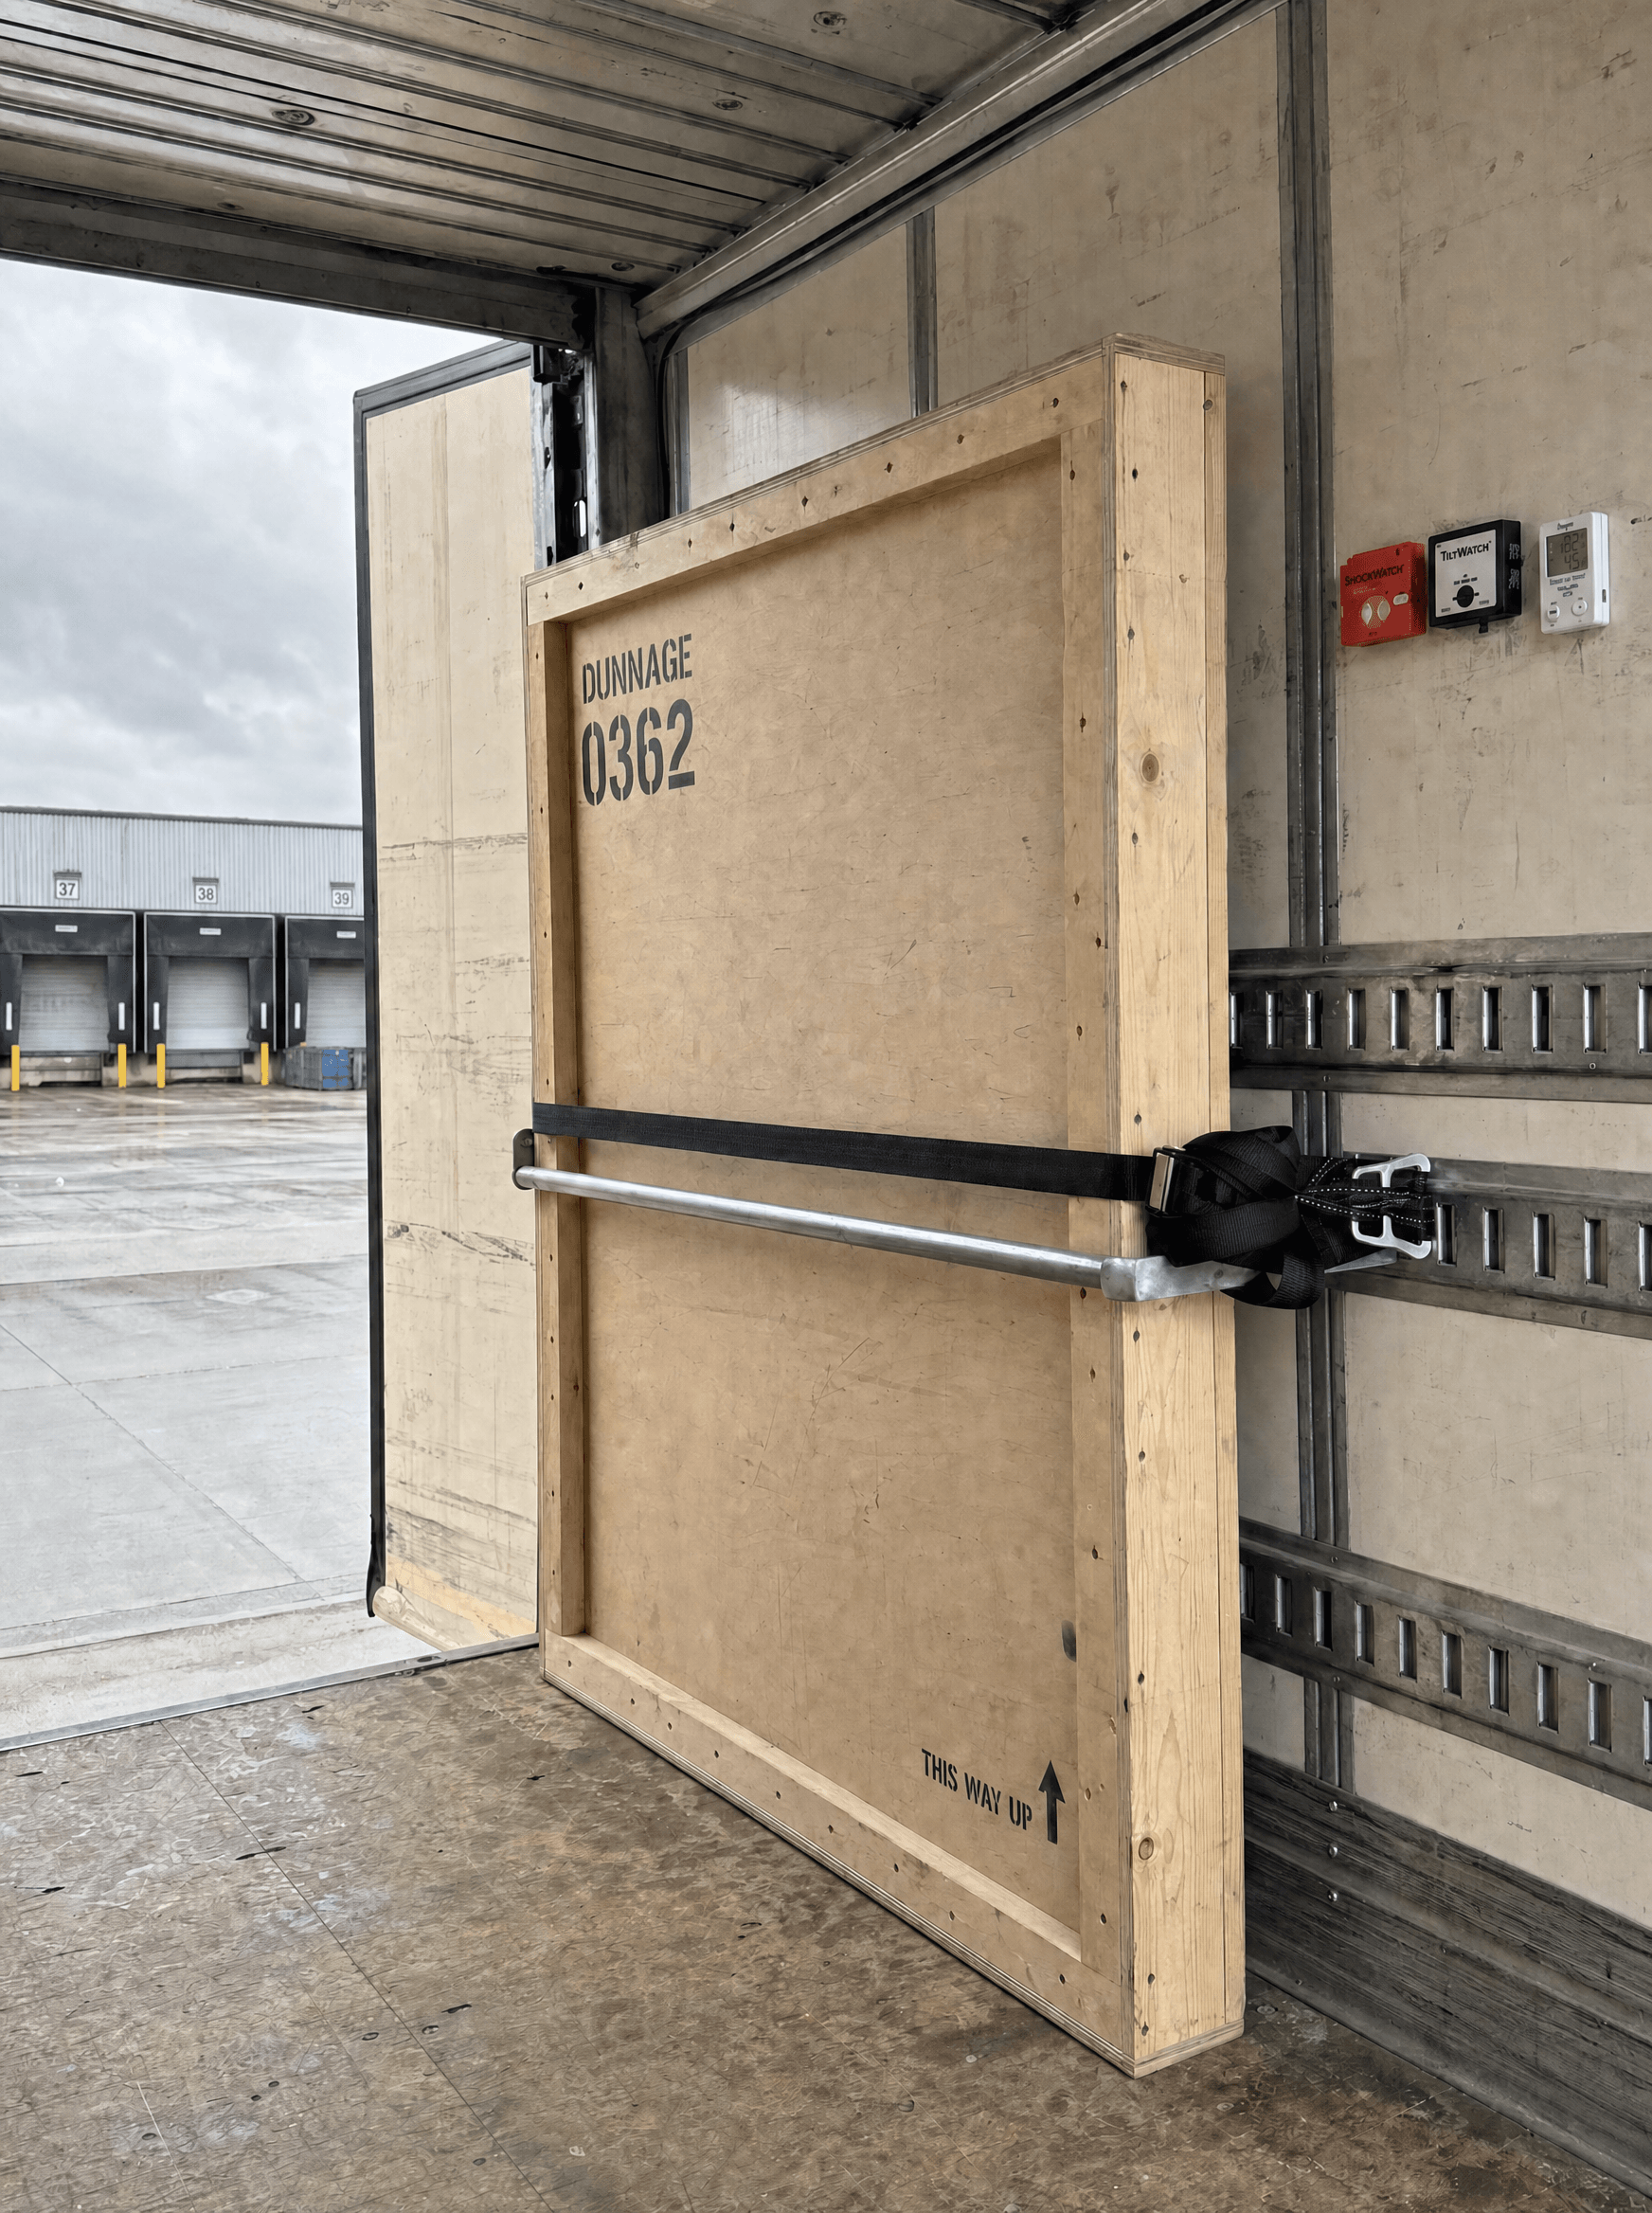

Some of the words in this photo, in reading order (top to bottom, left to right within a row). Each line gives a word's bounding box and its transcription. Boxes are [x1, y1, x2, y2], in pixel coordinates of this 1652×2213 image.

[583, 633, 692, 705] DUNNAGE
[582, 698, 695, 806] 0362
[59, 882, 76, 896] 37
[198, 887, 215, 901] 38
[333, 891, 350, 905] 39
[922, 1748, 958, 1792] THIS
[964, 1772, 1001, 1816] WAY
[1009, 1796, 1032, 1831] UP
